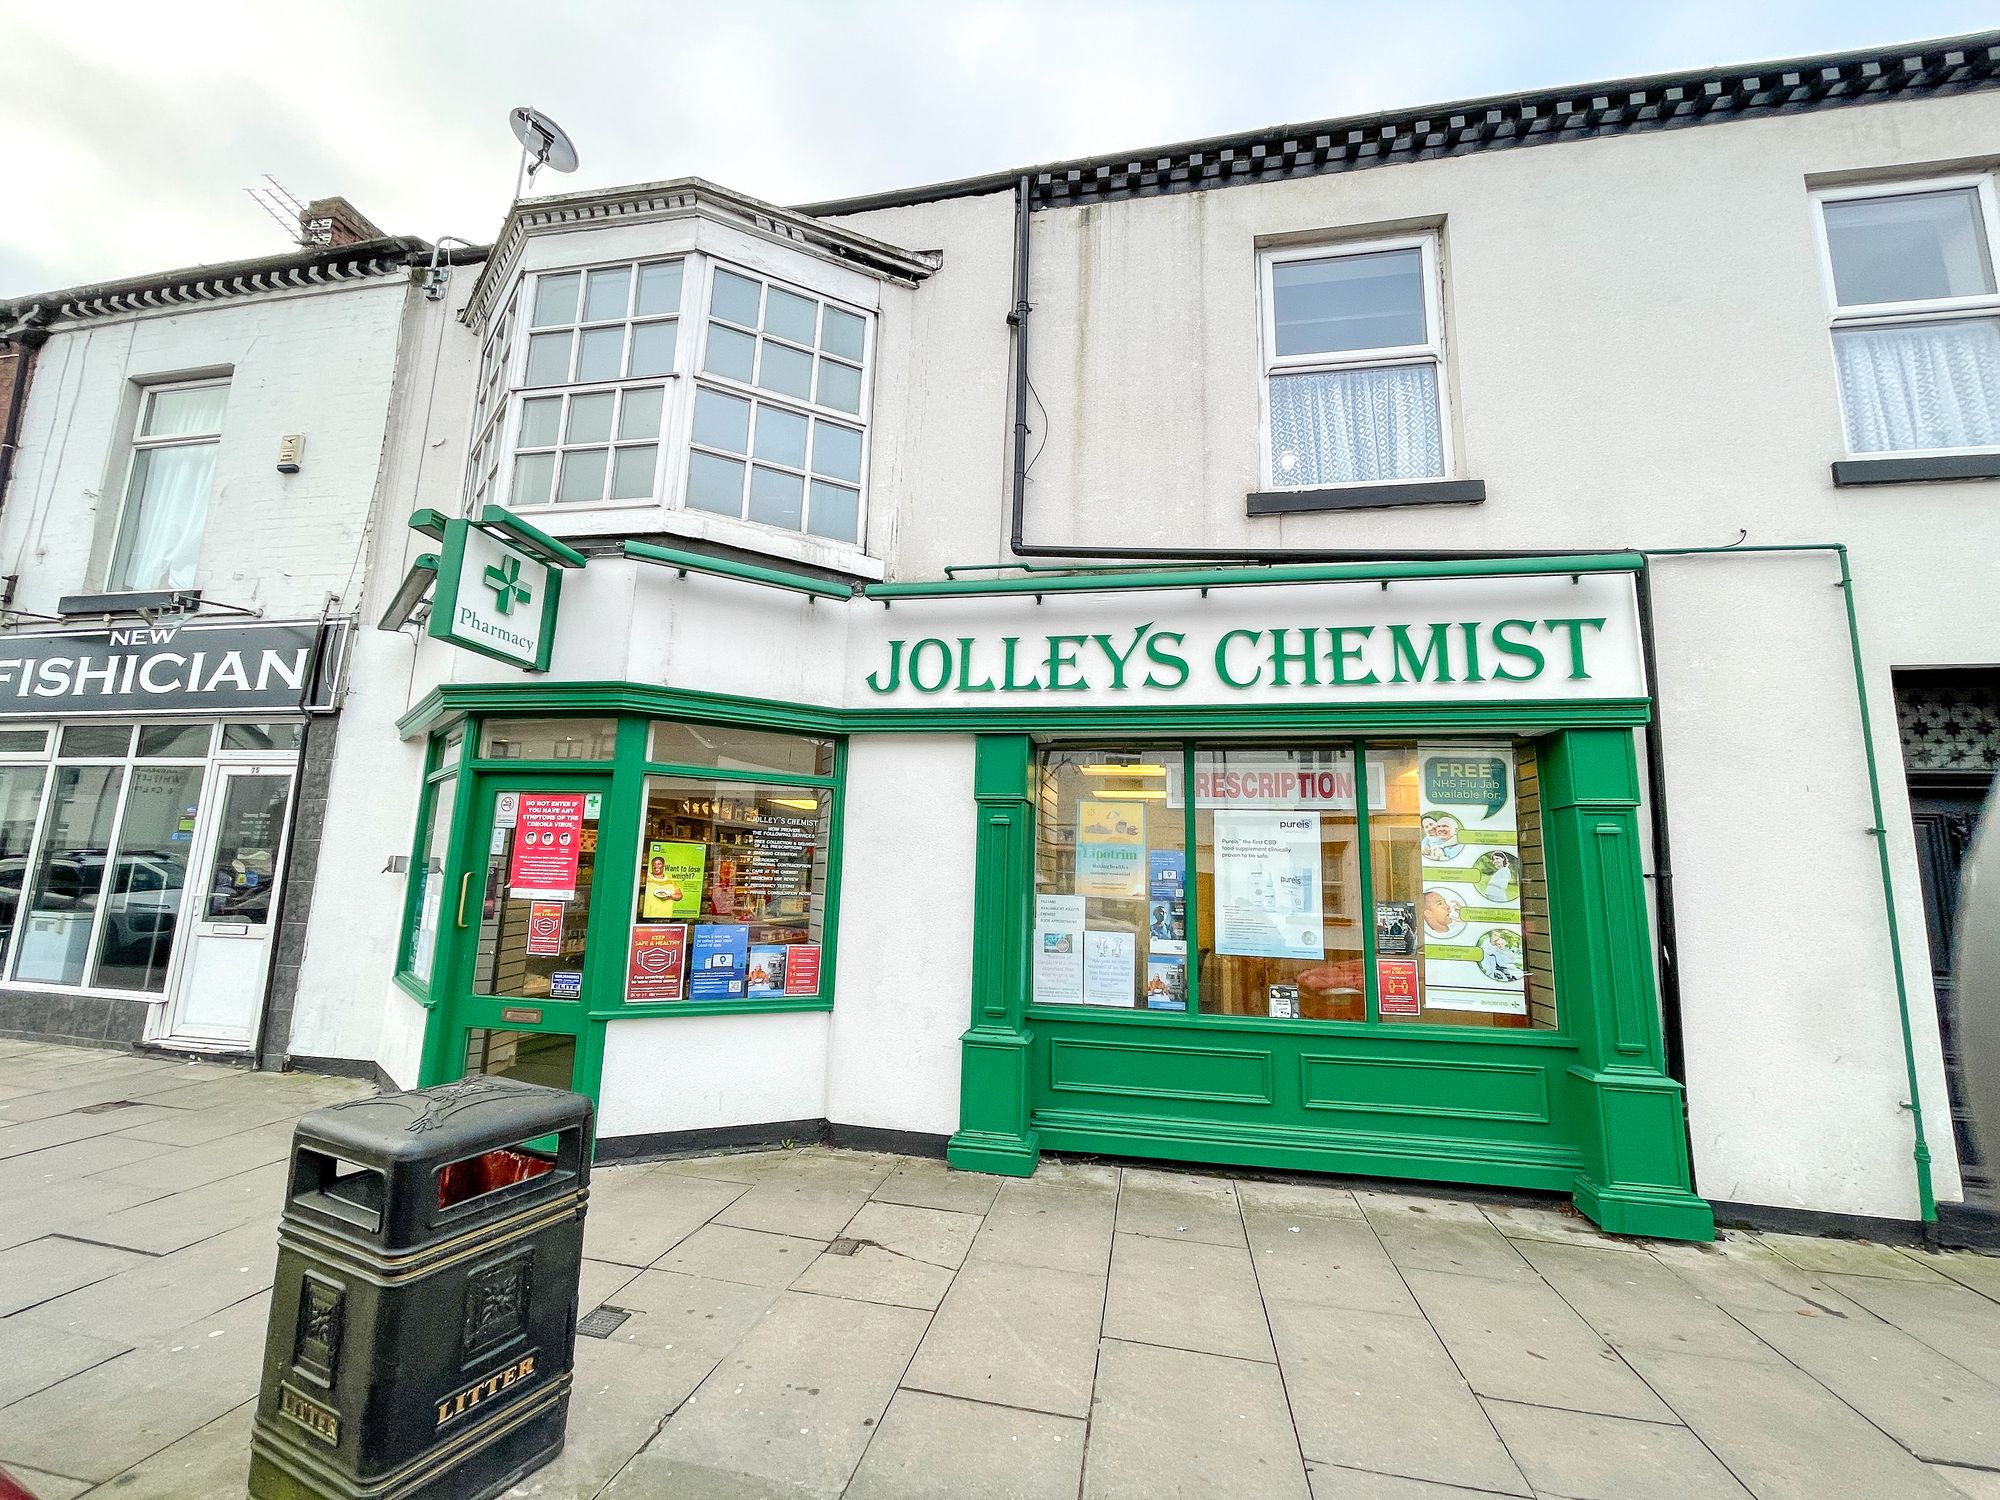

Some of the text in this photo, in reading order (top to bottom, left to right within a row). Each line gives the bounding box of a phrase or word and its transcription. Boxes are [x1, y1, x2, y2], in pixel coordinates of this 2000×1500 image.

[460, 606, 534, 653] Pharmacy
[109, 629, 178, 647] NEW
[1214, 617, 1607, 688] CHEMIST
[1436, 763, 1492, 778] FREE
[1432, 780, 1500, 789] NHS Flu Jab
[1431, 790, 1501, 799] available for:
[787, 818, 818, 827] CHEMIST
[1280, 820, 1310, 829] pureis
[1082, 848, 1137, 861] Lipotrim
[664, 864, 680, 872] Want
[672, 872, 696, 881] weight?
[1280, 875, 1302, 885] pureis
[437, 1356, 534, 1425] LITTER
